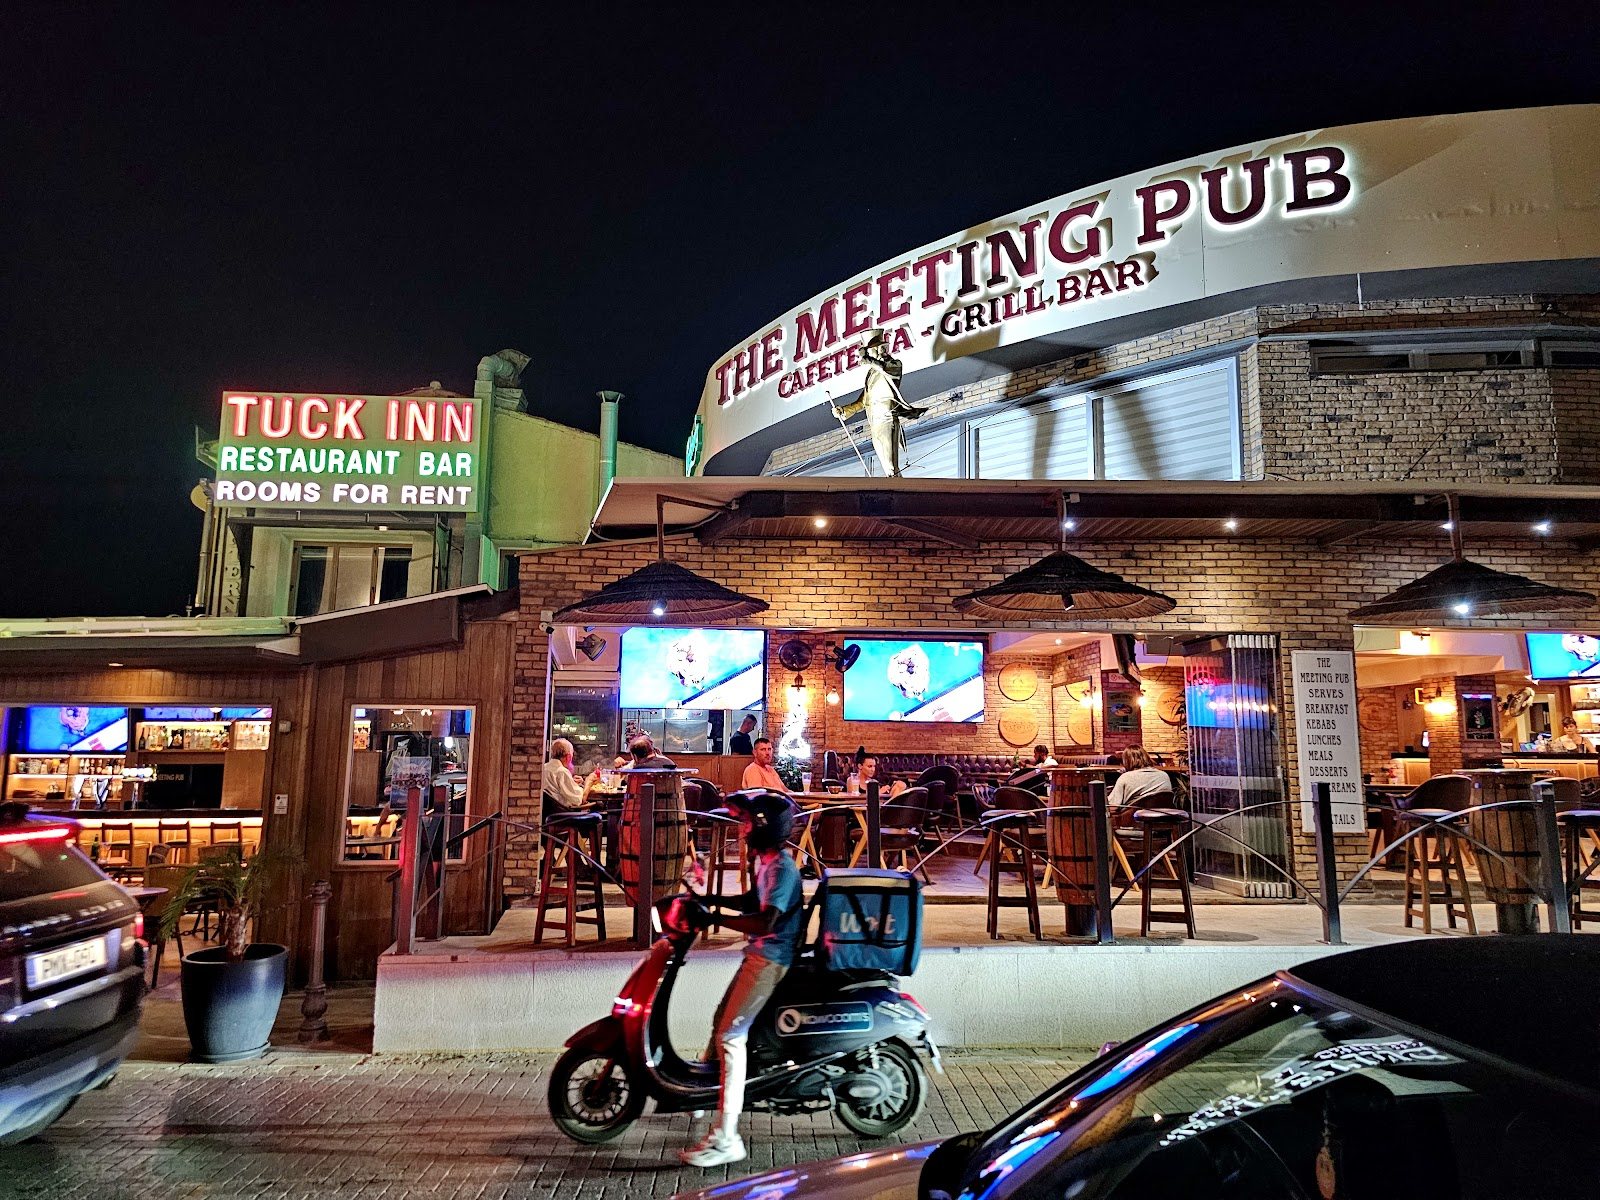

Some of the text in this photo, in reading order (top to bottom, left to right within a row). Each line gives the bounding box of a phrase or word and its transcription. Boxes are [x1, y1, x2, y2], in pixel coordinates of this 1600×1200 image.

[715, 145, 1353, 406] THE MEETING PUB
[777, 326, 914, 399] CAFETEA
[940, 285, 1046, 337] GRILL
[1056, 260, 1145, 306] BAR
[227, 395, 474, 442] TUCK INN
[220, 446, 472, 477] RESTAURANT BAR
[216, 480, 472, 506] ROOMS FOR RENT
[1316, 657, 1331, 668] THE
[1300, 672, 1350, 684] MEETING PUB
[1308, 688, 1344, 699] SERVES
[1305, 703, 1349, 715] BREAKFAST
[1306, 718, 1336, 730] KEBABS
[1307, 734, 1341, 746] LUNCHES
[1308, 750, 1333, 761] MEALS
[1309, 766, 1348, 777] DESSERTS
[1329, 782, 1357, 793] REAMS
